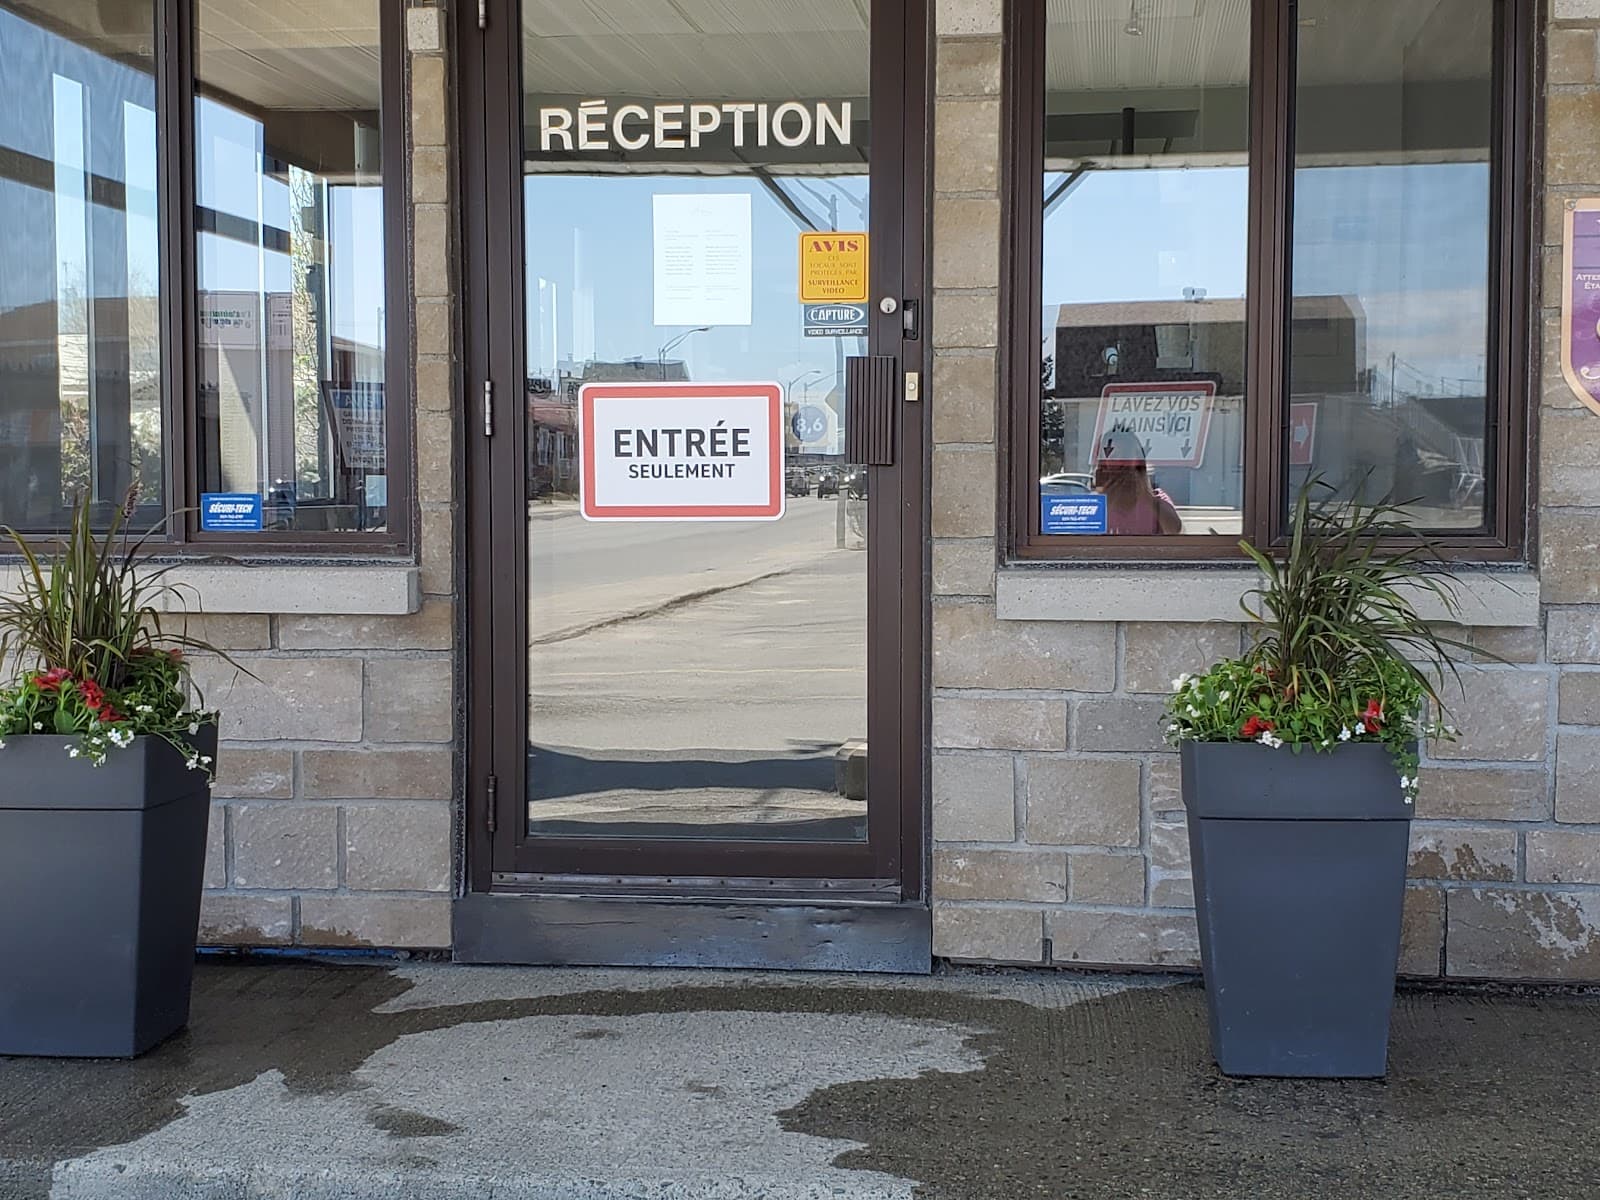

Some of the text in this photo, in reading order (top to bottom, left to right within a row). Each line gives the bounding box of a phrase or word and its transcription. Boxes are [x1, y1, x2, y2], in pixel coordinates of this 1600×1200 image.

[540, 99, 851, 151] RÉCEPTION
[808, 240, 859, 252] AVIS
[810, 308, 855, 321] CAPTURE
[1111, 395, 1200, 413] LAVEZ VOS
[1112, 416, 1166, 432] MAINS
[613, 419, 751, 458] ENTRÉE
[628, 463, 736, 479] SEULEMENT
[209, 501, 254, 514] SÉCURI-TECH
[1050, 503, 1098, 515] SÉCURI-TECH
